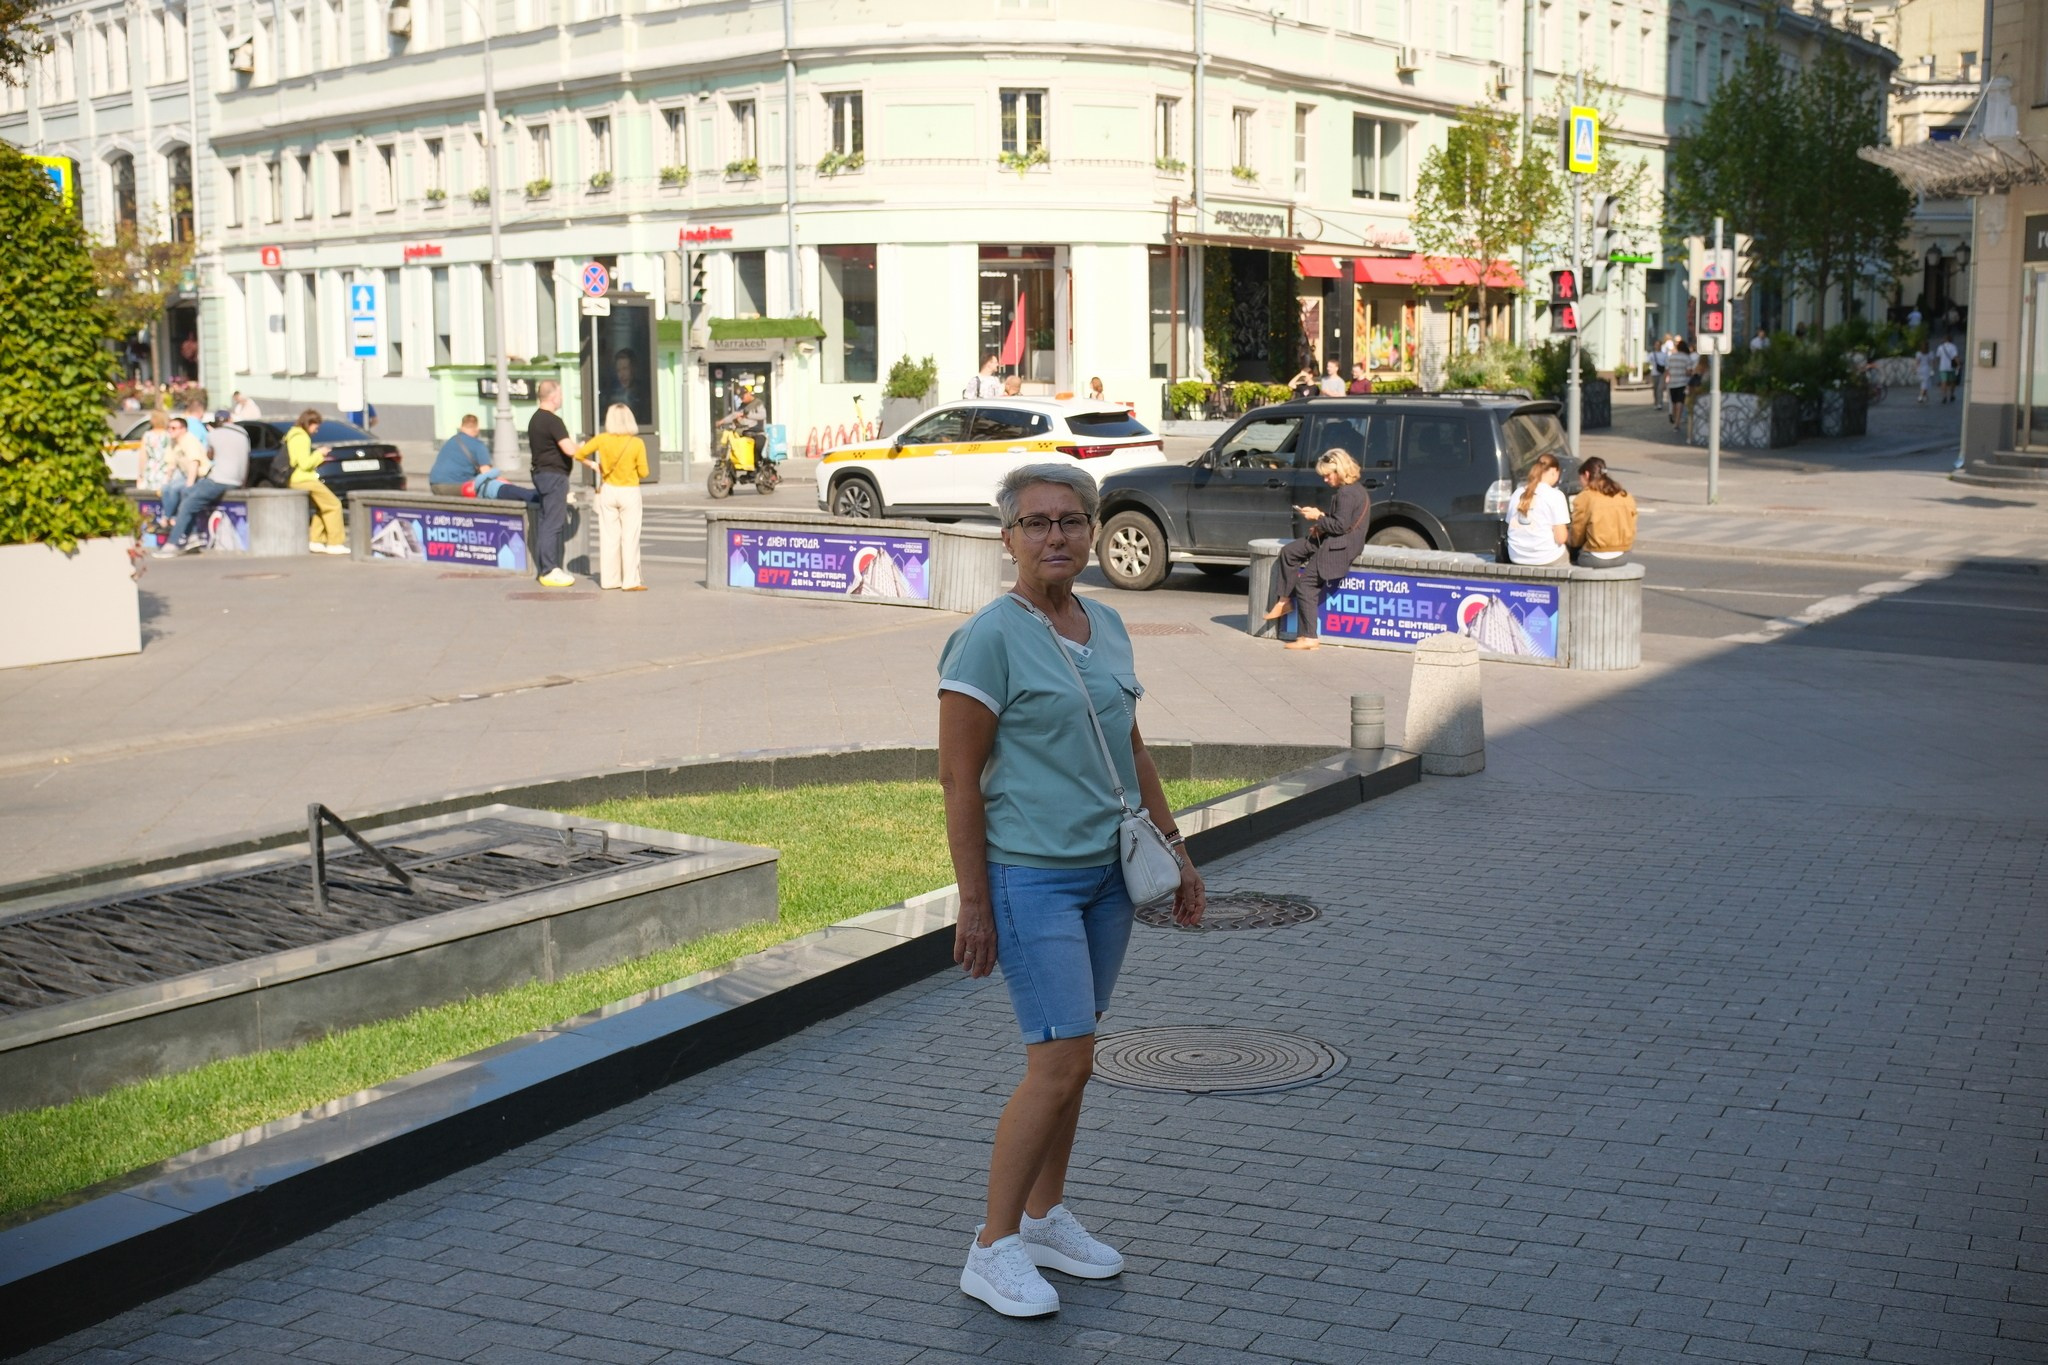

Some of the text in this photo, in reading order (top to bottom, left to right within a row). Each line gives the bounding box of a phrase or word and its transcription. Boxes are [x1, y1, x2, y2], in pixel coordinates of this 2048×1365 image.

[714, 339, 767, 348] Marrakesh
[427, 527, 495, 546] МОСКВА!
[428, 541, 456, 557] 877
[758, 549, 847, 570] МОСКВА!
[758, 567, 790, 585] 877
[791, 578, 847, 589] ДЕНЬ ГОРОДА
[811, 571, 847, 580] СЕНТЯБРЯ
[1326, 593, 1447, 620] МОСКВА!
[1326, 613, 1370, 635] 877
[1398, 620, 1447, 632] СЕНТЯБРЯ
[1371, 627, 1401, 638] ДЕНЬ
